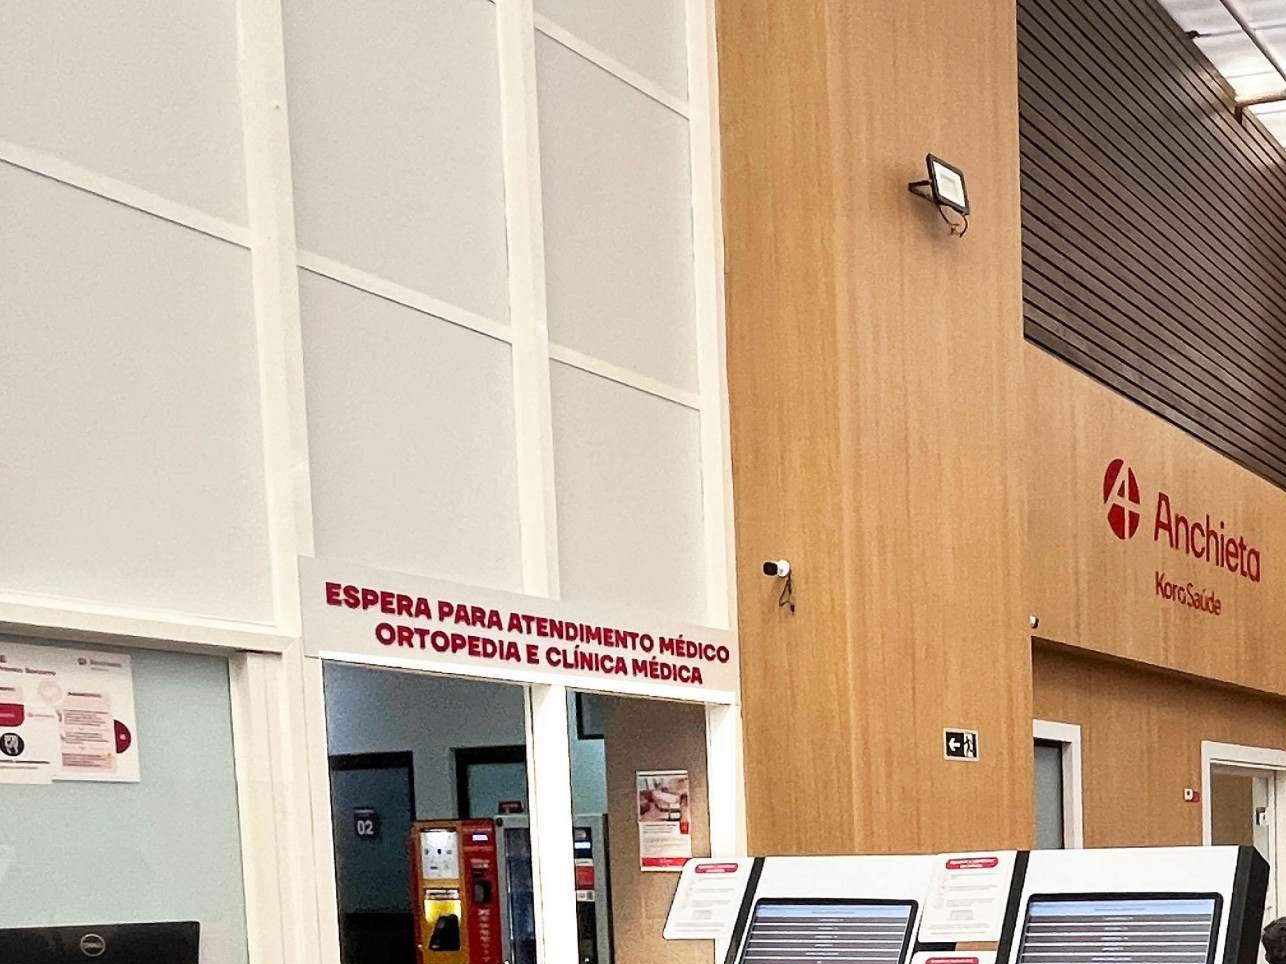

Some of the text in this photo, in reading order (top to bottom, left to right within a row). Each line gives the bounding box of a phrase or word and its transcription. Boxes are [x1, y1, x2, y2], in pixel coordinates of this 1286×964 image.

[1153, 491, 1261, 582] Anchieta
[325, 581, 730, 663] ESPERA PARA ATENDIMENTO MÉDICO
[375, 622, 703, 684] ORTOPEDIA E CLÍNICA MÉDICA
[357, 820, 374, 835] 02
